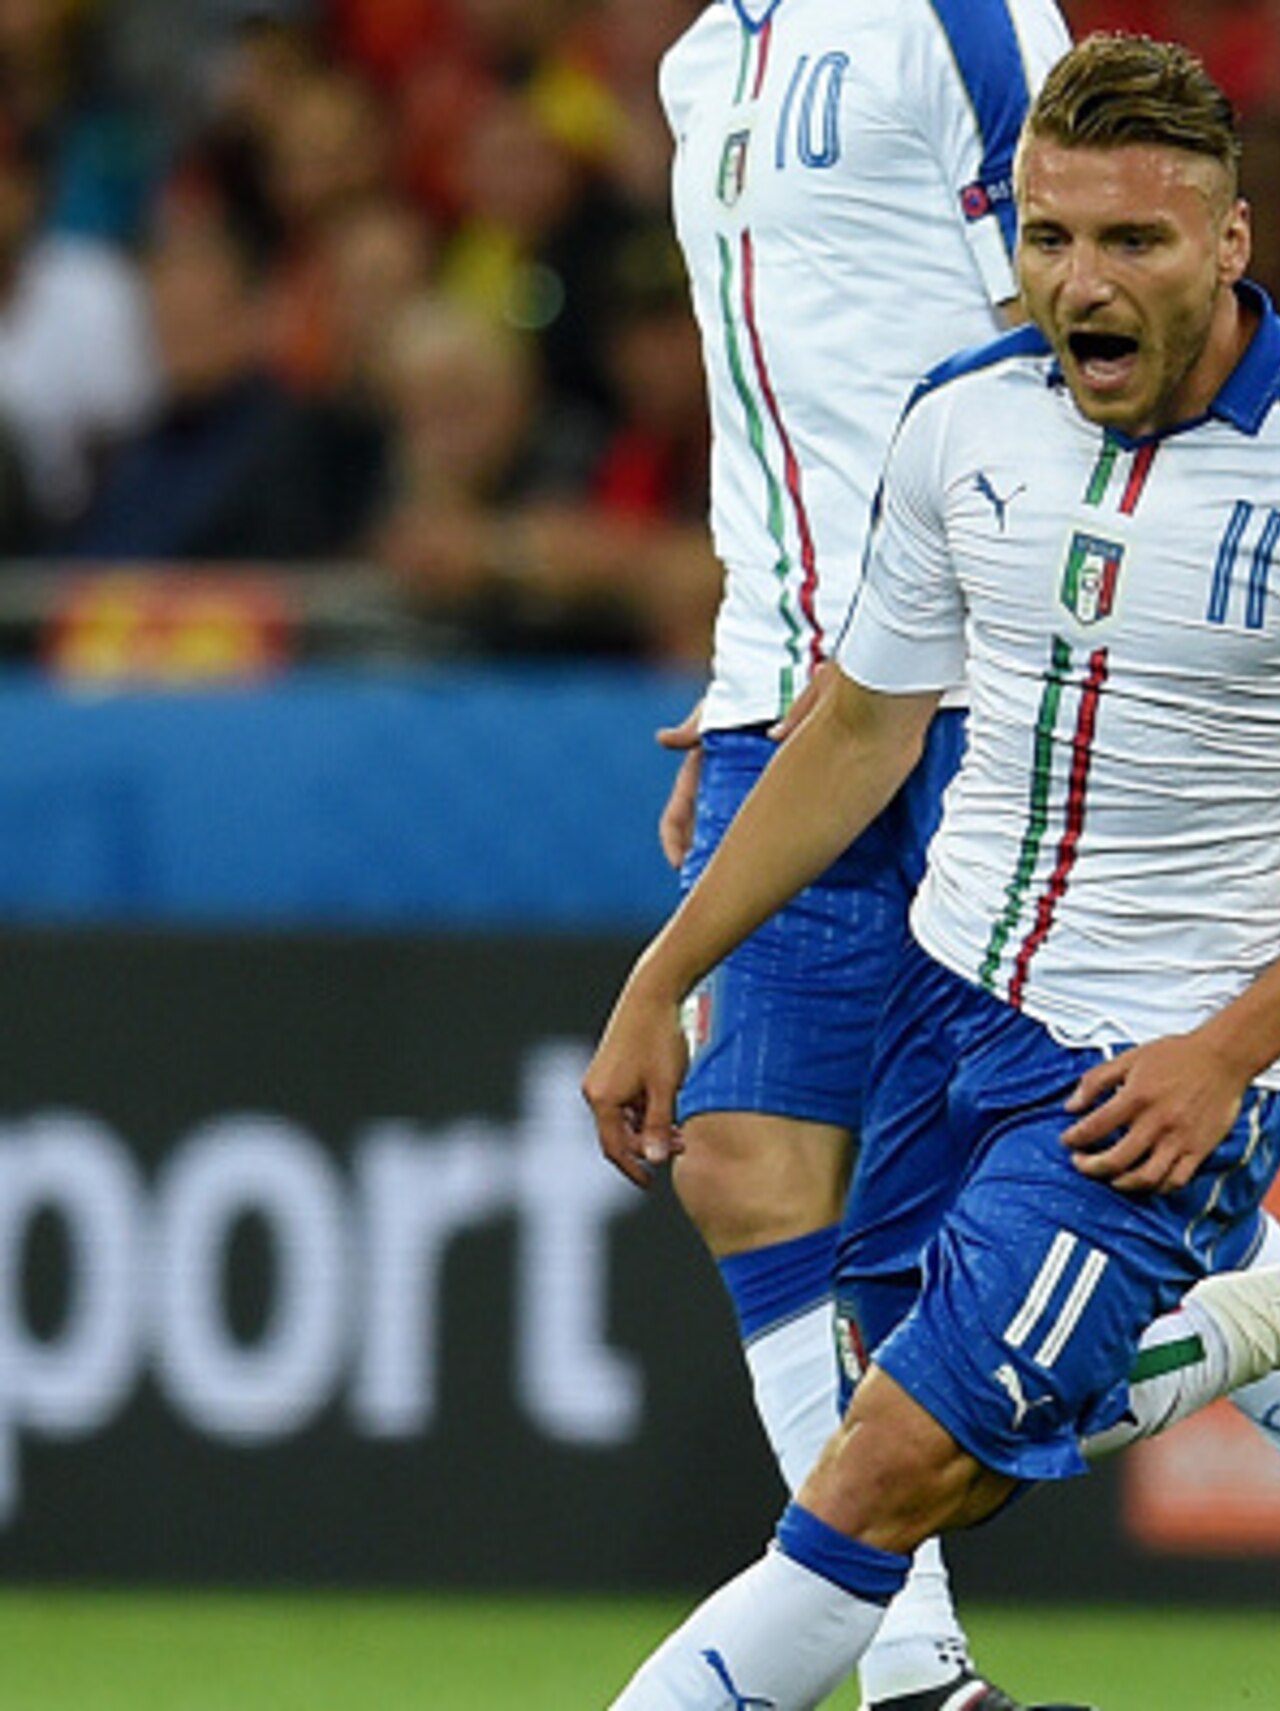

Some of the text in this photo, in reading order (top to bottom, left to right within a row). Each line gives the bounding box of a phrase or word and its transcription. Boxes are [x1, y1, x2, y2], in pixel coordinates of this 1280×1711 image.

[775, 51, 849, 170] 10
[0, 1038, 644, 1528] port
[1003, 1229, 1109, 1369] 11
